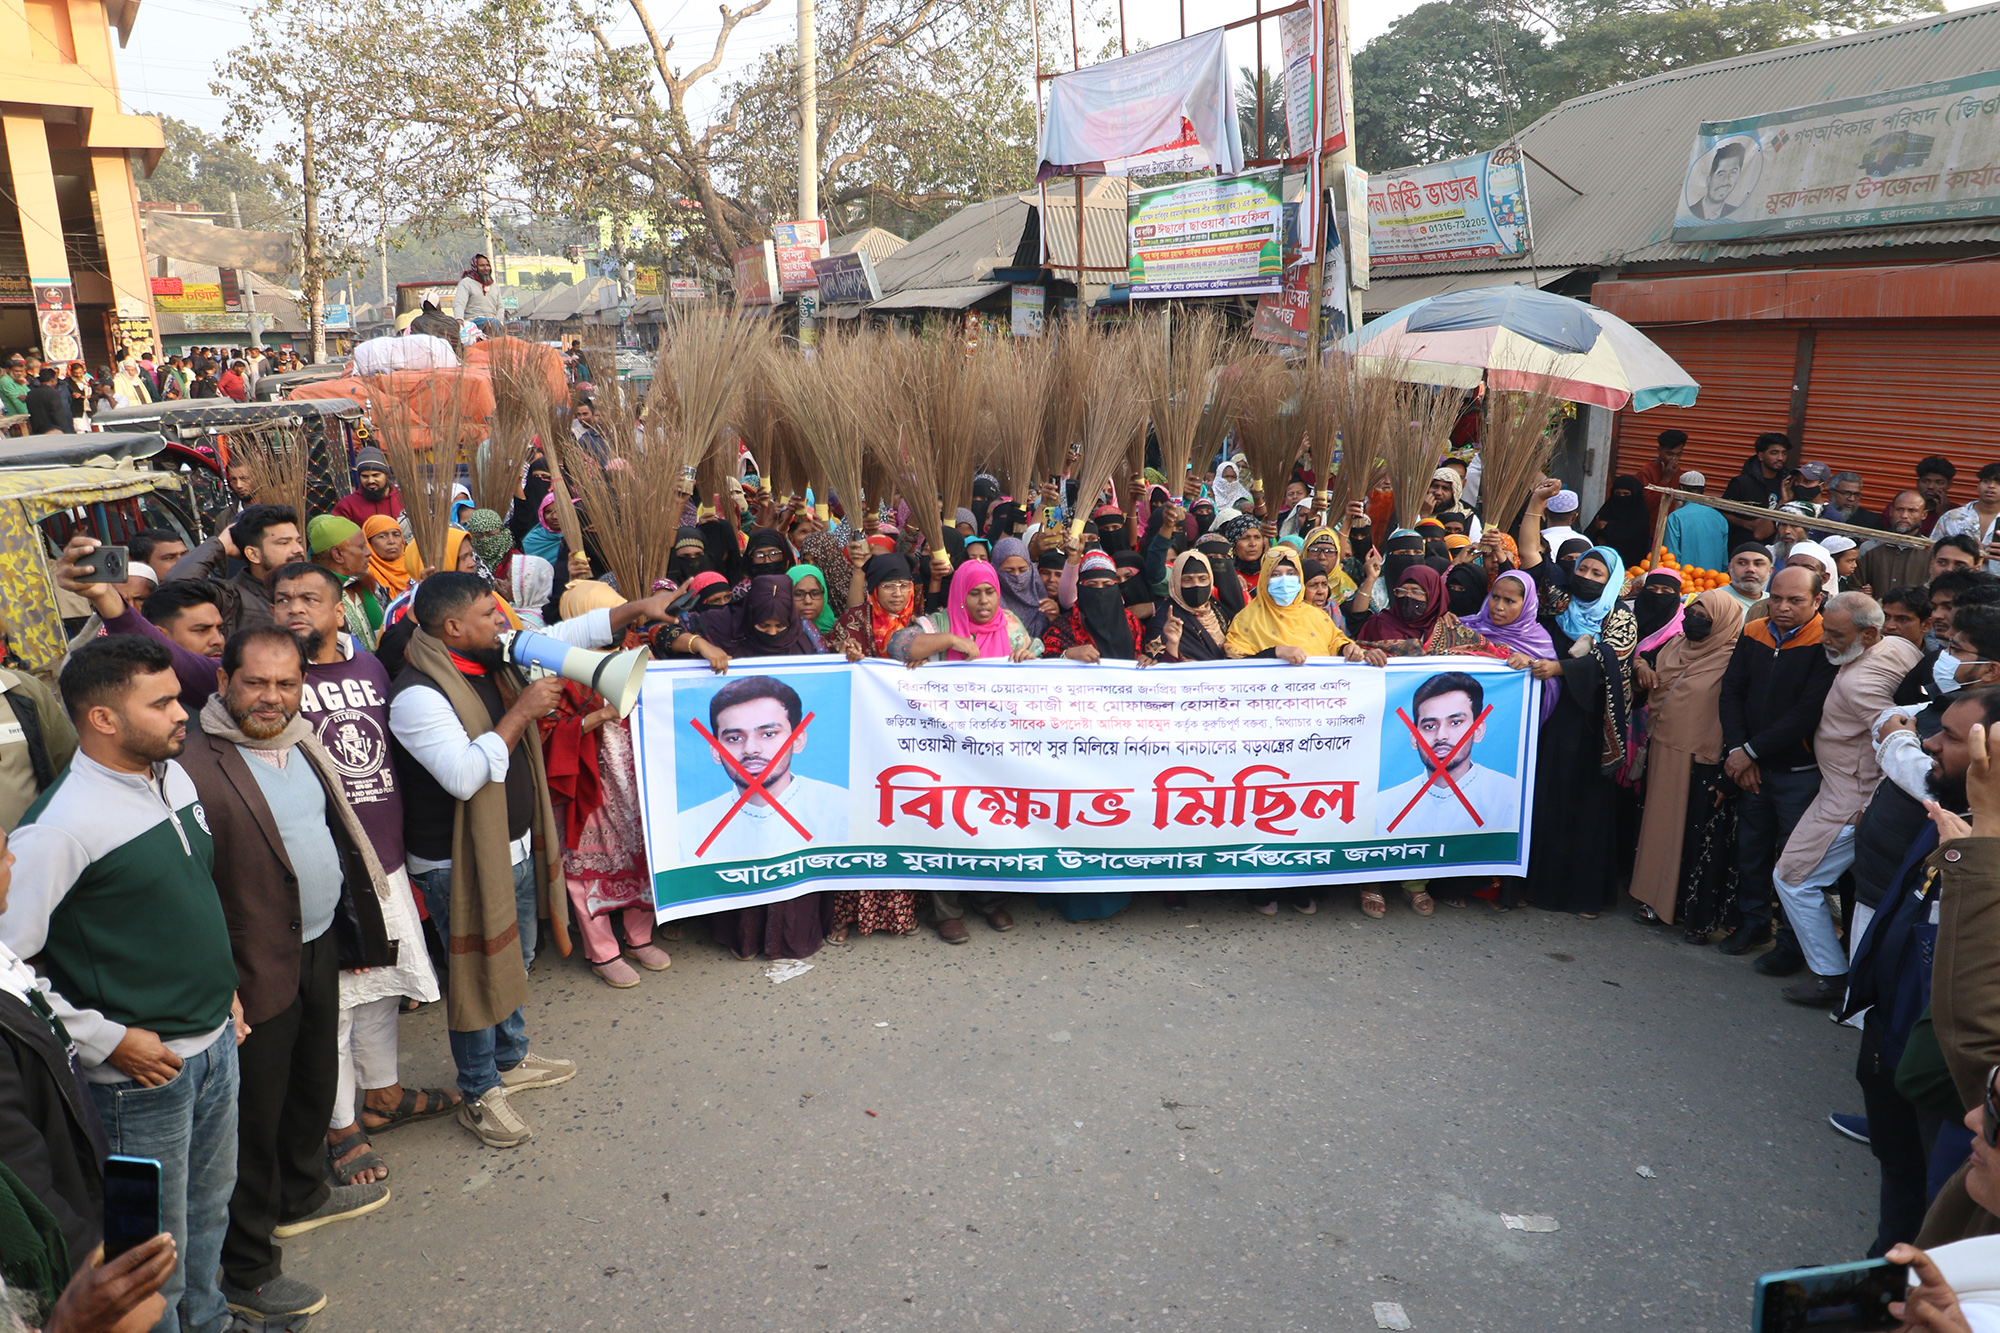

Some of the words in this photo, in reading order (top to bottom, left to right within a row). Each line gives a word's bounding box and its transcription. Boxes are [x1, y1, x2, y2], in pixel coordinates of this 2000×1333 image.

[1794, 118, 1877, 145] গণঅধিকার
[1882, 107, 1942, 131] পরিষদ
[1387, 180, 1420, 212] মিষ্টি
[1423, 176, 1479, 206] ভাণ্ডার
[1765, 184, 1850, 215] মুরাদনগর
[1854, 173, 1940, 201] উপজেলা
[1189, 217, 1225, 231] ছাওয়াব
[1228, 210, 1270, 226] মাহফিল
[1429, 217, 1487, 233] 01316-732205
[898, 680, 948, 693] বিএনপির
[953, 681, 986, 693] ভাইস
[991, 684, 1048, 694] চেয়ারম্যান
[1053, 685, 1062, 694] ও
[1067, 684, 1133, 696] মুরাদনগরের
[1138, 682, 1177, 695] জনপ্রিয়
[1182, 682, 1226, 695] জনন্দিত
[1231, 683, 1266, 694] সাবেক
[1271, 685, 1278, 693] ৫
[1285, 682, 1316, 692] বারের
[1320, 679, 1351, 692] এমপি
[906, 698, 949, 711] জনাব
[956, 699, 1018, 716] আলহাজ্ব
[1026, 696, 1062, 712] কাজী
[1068, 699, 1097, 713] শাহ
[1103, 700, 1175, 712] মোফাজ্জল
[1180, 697, 1240, 711] হোসাইন
[1246, 697, 1348, 710] কায়কোবাদকে
[886, 714, 916, 727] জড়িয়ে
[920, 717, 966, 731] দুর্নীতিবাজ
[969, 719, 1006, 730] বিতর্কিত
[1010, 718, 1045, 730] সাবেক
[1050, 717, 1092, 730] উপদেষ্টা
[1097, 717, 1132, 730] আসিফ
[1136, 719, 1170, 732] মাহমুদ
[1174, 717, 1198, 732] কর্তৃক
[1201, 717, 1240, 731] কুরুচিপূর্ণ
[1275, 716, 1311, 728] মিথ্যাচার
[1315, 719, 1323, 727] ও
[1326, 714, 1366, 728] ফ্যাসিবাদী
[897, 735, 957, 753] আওয়ামী
[962, 736, 1004, 757] লীগের
[1010, 741, 1043, 757] সাথে
[1047, 741, 1068, 760] সুর
[1073, 737, 1120, 756] মিলিয়ে
[1124, 736, 1170, 756] নির্বাচন
[1176, 739, 1236, 755] বানচালের
[1242, 738, 1294, 757] ষড়যন্ত্রের
[1298, 733, 1352, 752] প্রতিবাদে
[380, 768, 393, 788] 15
[874, 764, 1135, 837] বিক্ষোভ
[1152, 764, 1360, 836] মিছিল
[898, 852, 1048, 873] মুরাদনগর
[1055, 848, 1207, 871] উপজেলার
[1214, 845, 1335, 868] সর্বস্তরের
[1342, 843, 1430, 863] জনগন
